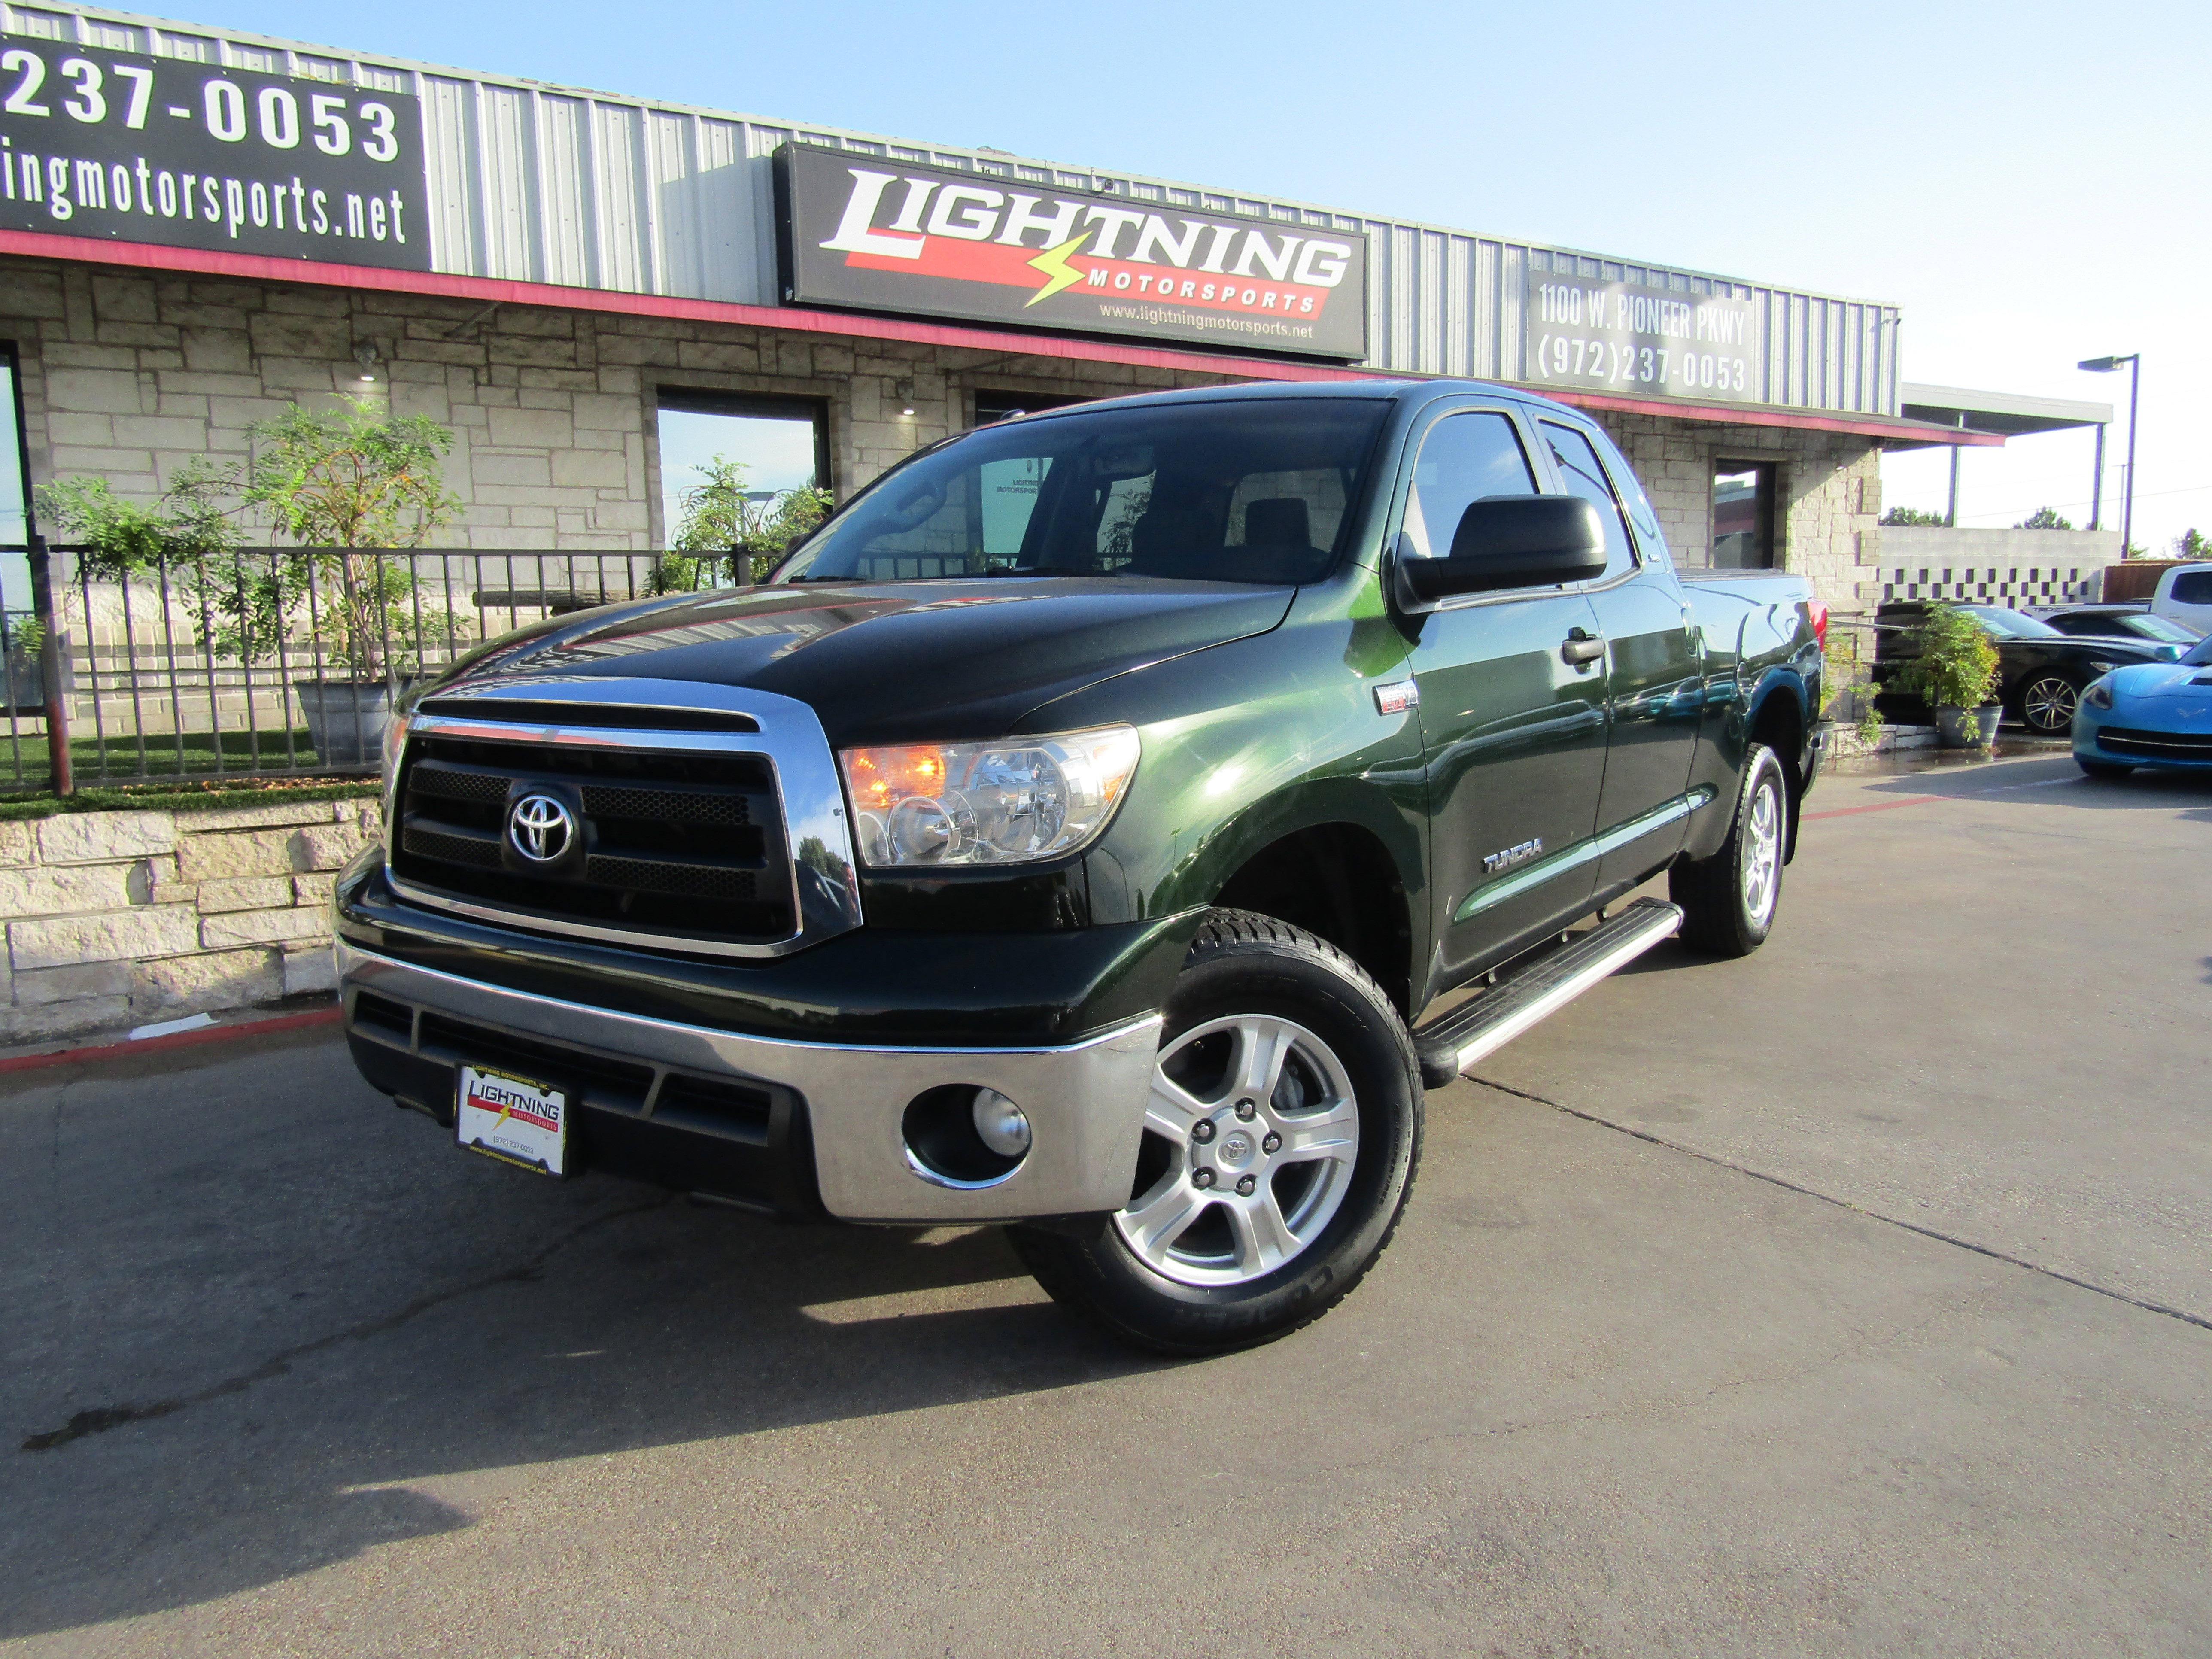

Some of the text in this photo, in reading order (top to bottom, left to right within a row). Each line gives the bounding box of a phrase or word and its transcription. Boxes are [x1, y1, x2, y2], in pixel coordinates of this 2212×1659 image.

[2, 49, 399, 162] 237-0053
[819, 168, 1351, 287] LIGHTNING
[1088, 270, 1316, 313] MOTORSPORTS
[1100, 304, 1313, 338] www.lightningmotorsports.net
[1539, 284, 1745, 346] 1100 W. PIONEER PKWY
[1483, 838, 1542, 873] TUNDRA
[468, 1079, 559, 1121] LIGHTNING
[514, 1111, 557, 1130] MOTORSPORTS
